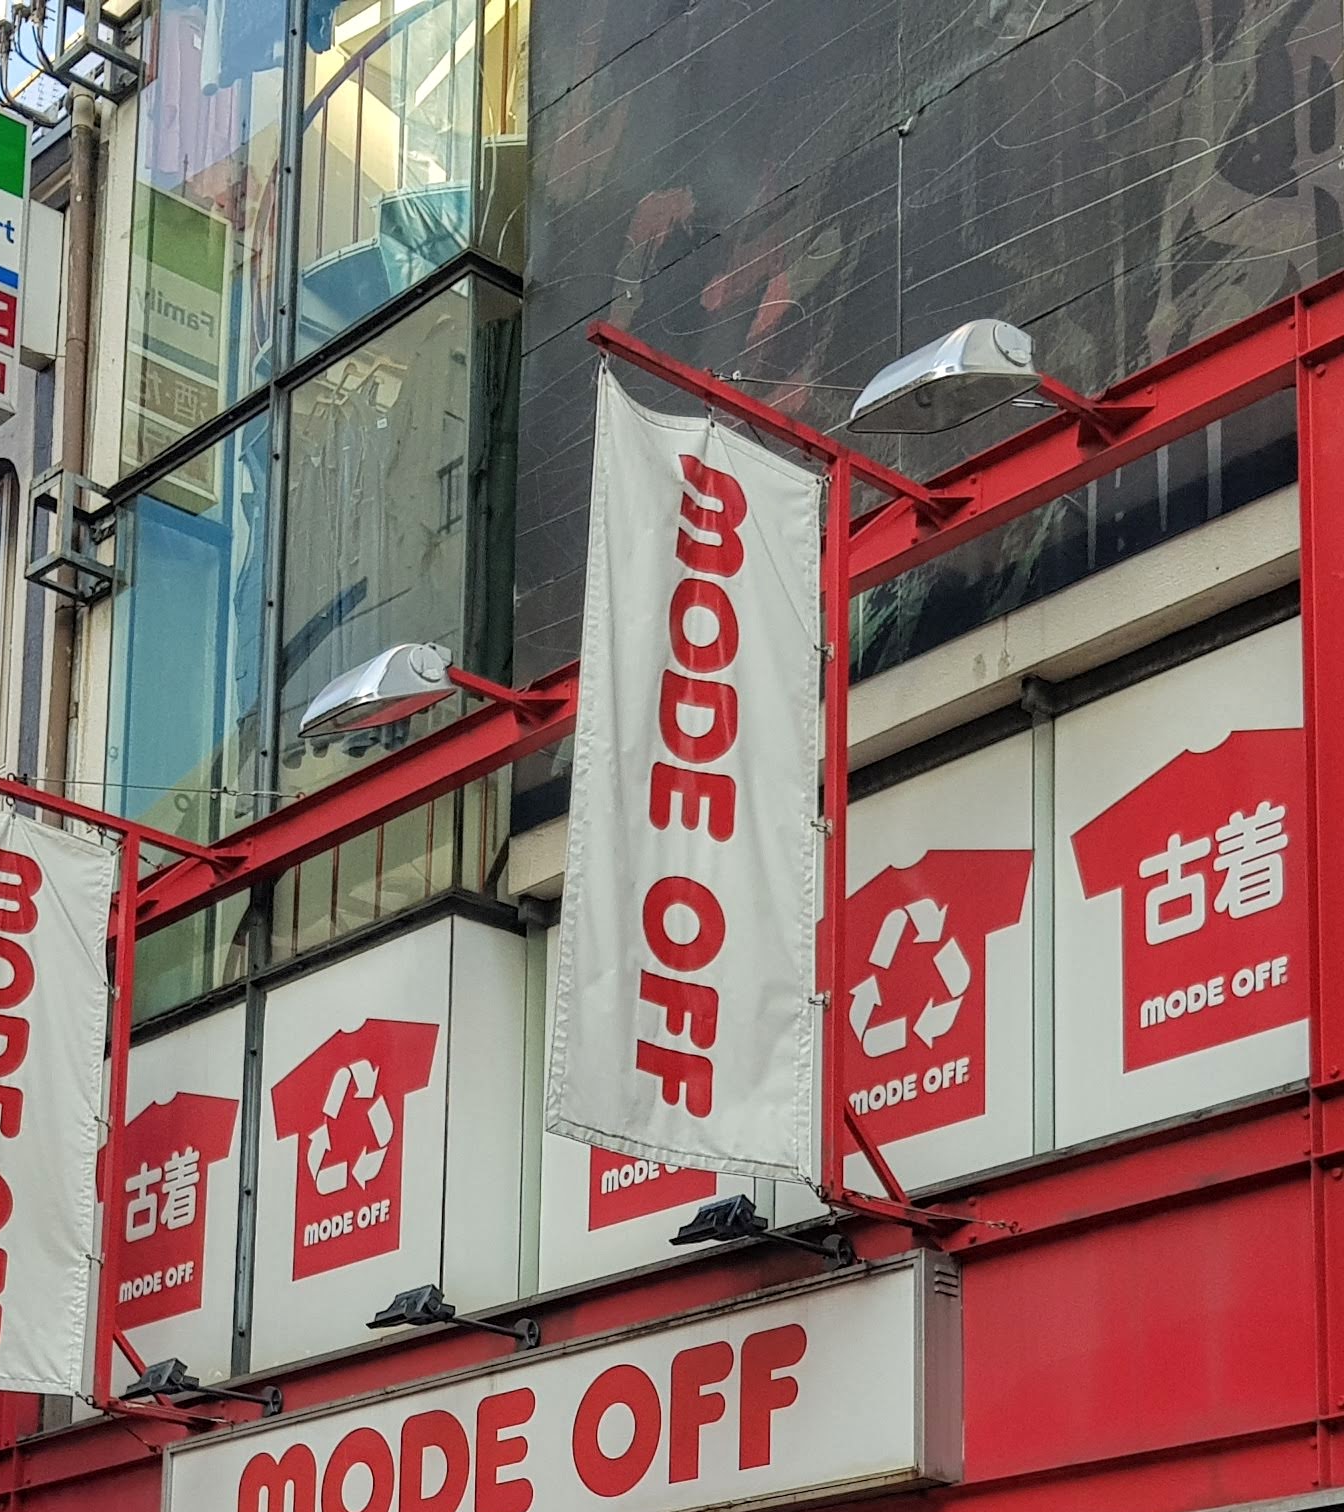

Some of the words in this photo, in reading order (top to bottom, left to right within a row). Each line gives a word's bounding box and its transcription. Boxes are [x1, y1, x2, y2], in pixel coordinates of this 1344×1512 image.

[648, 453, 749, 842] MODE
[1139, 800, 1289, 946] 古着
[636, 875, 727, 1119] OFF
[1140, 976, 1224, 1029] MODE
[1231, 956, 1288, 999] OFF
[848, 1073, 917, 1116] MODE
[923, 1057, 970, 1095] OFF
[124, 1145, 200, 1243] 古着
[601, 1160, 660, 1195] MODE
[303, 1211, 354, 1248] MODE
[356, 1198, 391, 1232] OFF
[118, 1270, 162, 1304] MODE
[164, 1261, 194, 1290] OFF
[571, 1322, 807, 1498] OFF
